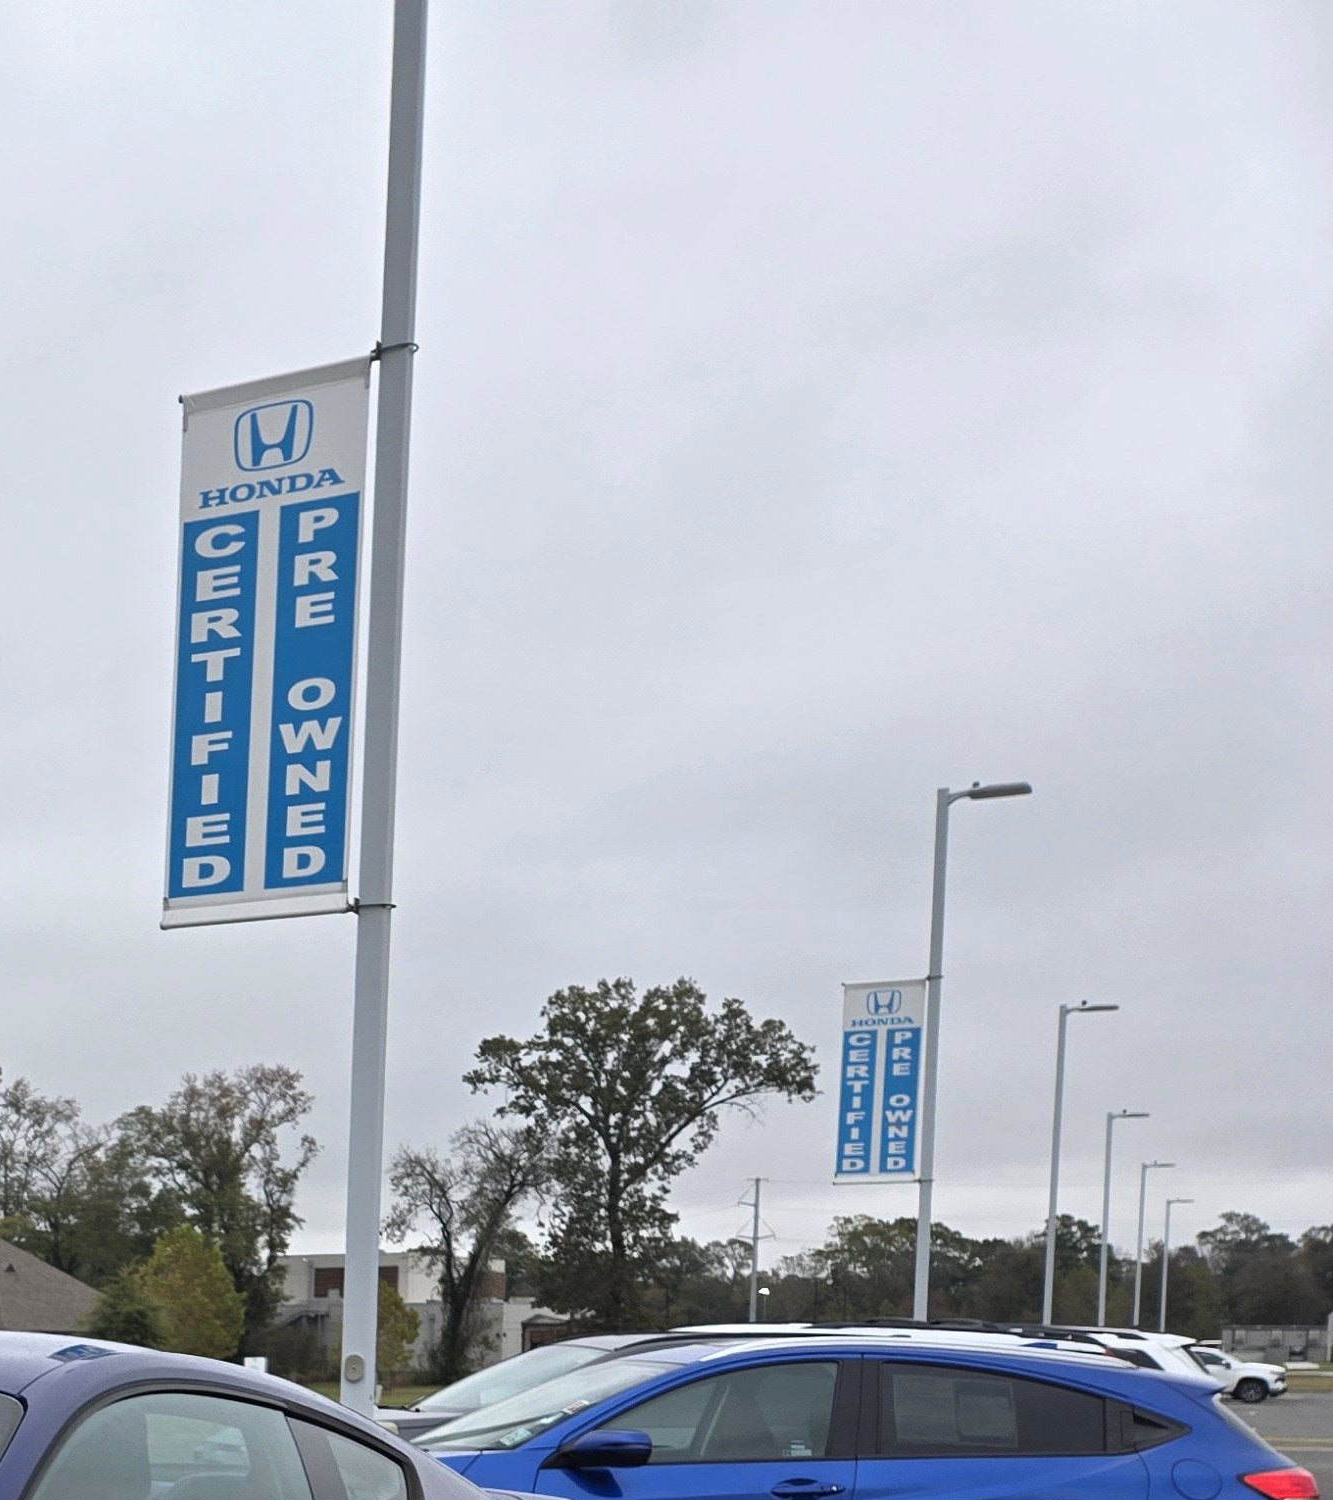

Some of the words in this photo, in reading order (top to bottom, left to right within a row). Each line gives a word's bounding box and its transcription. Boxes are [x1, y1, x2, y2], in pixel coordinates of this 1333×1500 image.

[198, 469, 345, 510] HONDA
[292, 507, 339, 628] PRE
[181, 524, 246, 890] CERTIFIED
[279, 676, 342, 879] OWNED
[851, 1016, 914, 1028] HONDA
[892, 1031, 913, 1076] PRE
[842, 1034, 871, 1171] CERTIFIED
[885, 1094, 913, 1170] OWNED
